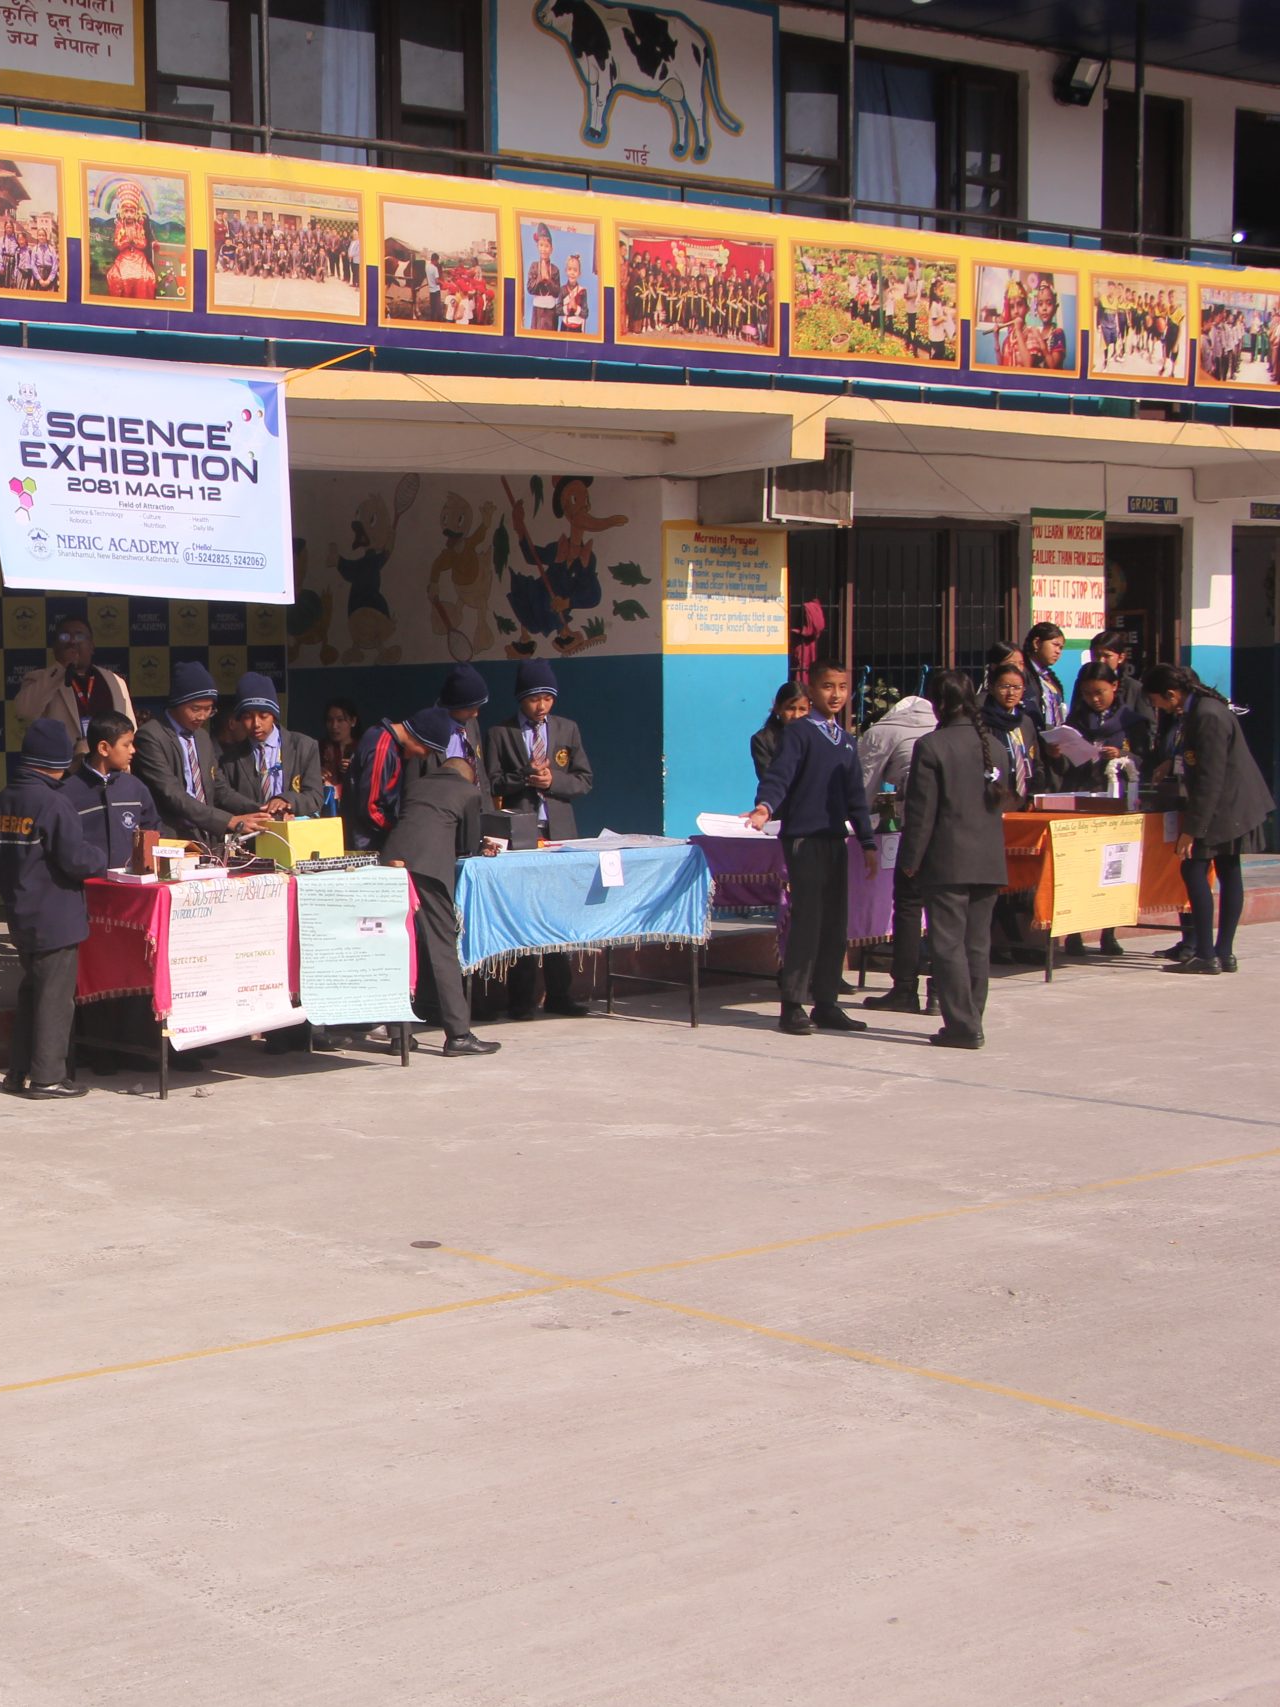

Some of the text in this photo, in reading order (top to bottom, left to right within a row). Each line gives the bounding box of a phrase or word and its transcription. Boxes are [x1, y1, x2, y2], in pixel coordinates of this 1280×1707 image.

[79, 13, 124, 39] विशाल
[6, 30, 39, 46] जय
[623, 144, 650, 166] गाई
[46, 410, 232, 452] SCIENCE
[19, 440, 259, 484] EXHIBITION
[67, 477, 222, 502] 2081 MAGH 12
[118, 501, 135, 509] Field
[143, 502, 175, 511] Attraction
[1130, 498, 1159, 512] GRADE
[694, 532, 757, 547] Morning Prayer
[1044, 525, 1064, 539] LEARN
[1067, 525, 1085, 540] MORE
[1086, 526, 1103, 540] FROM
[56, 534, 104, 551] NERIC
[108, 538, 180, 555] ACADEMY
[233, 555, 264, 567] 5242062
[1032, 550, 1056, 565] FAILURE
[1057, 550, 1072, 565] THAN
[1049, 579, 1103, 599] LET IT STOP YOU
